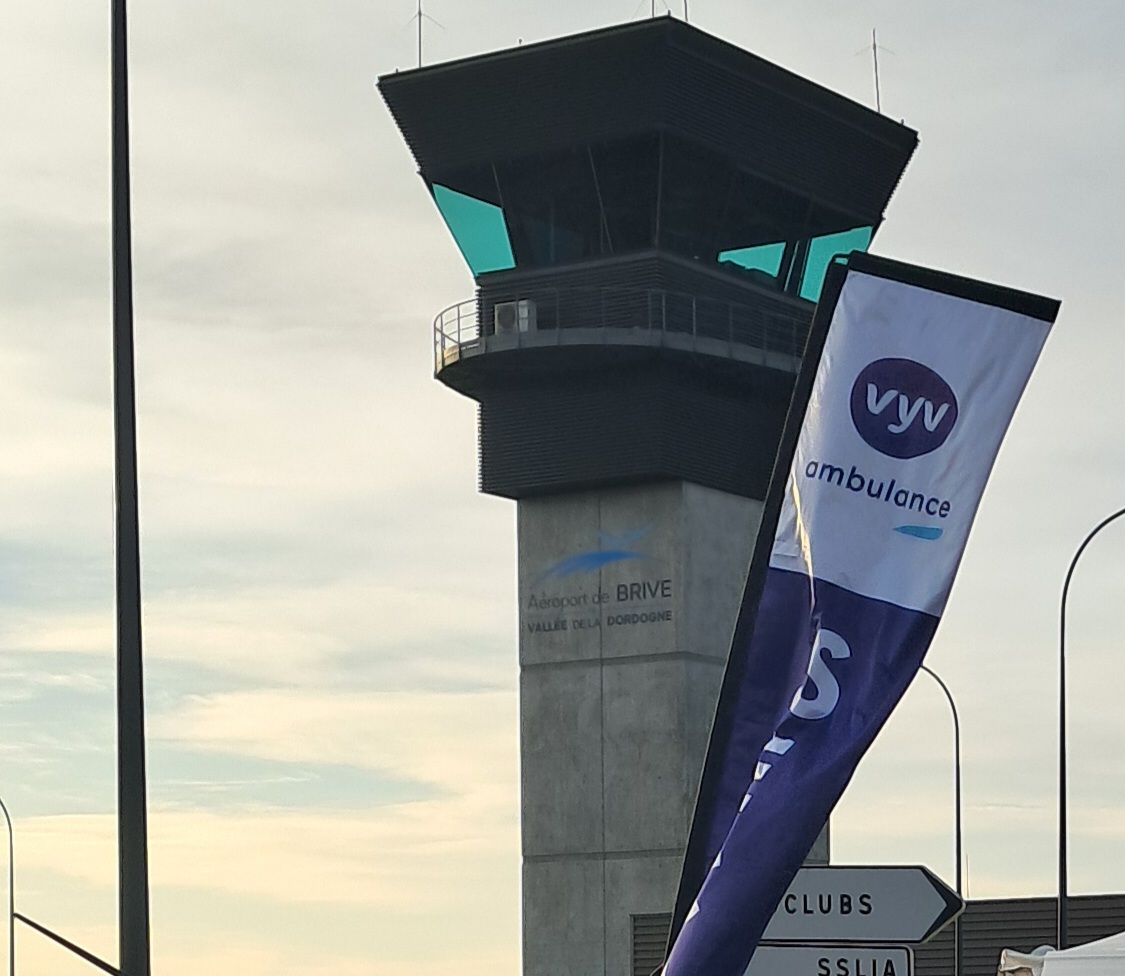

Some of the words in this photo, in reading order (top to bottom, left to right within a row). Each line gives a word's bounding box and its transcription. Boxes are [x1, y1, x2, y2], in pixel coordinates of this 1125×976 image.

[867, 383, 950, 434] vyv
[805, 461, 951, 518] ambulance
[528, 591, 588, 611] Aéroport
[592, 587, 609, 605] de
[617, 579, 672, 602] BRIVE
[607, 610, 672, 626] DORDOGNE
[784, 893, 873, 915] CLUBS
